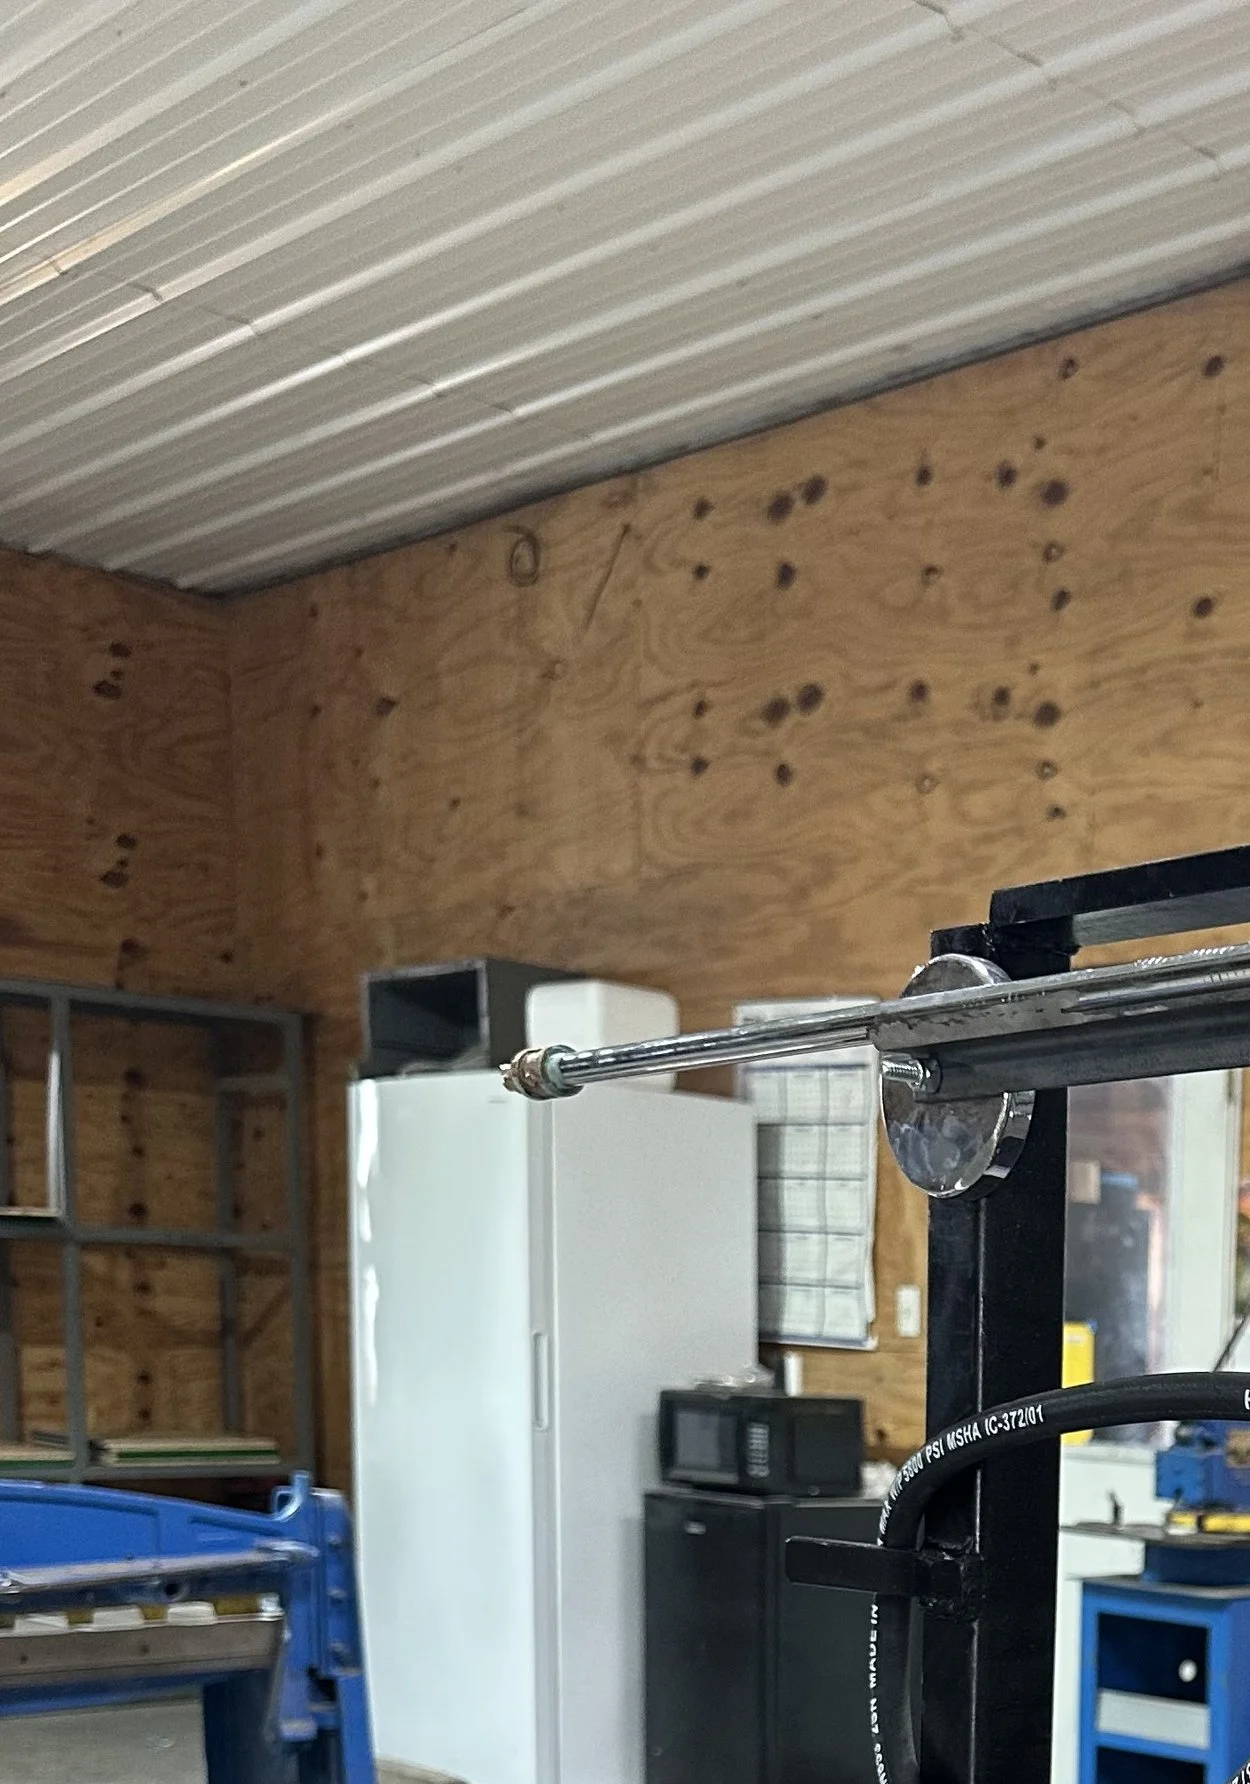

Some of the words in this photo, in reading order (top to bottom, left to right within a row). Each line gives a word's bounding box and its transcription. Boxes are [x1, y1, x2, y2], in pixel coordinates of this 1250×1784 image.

[902, 1451, 924, 1482] 5800
[925, 1437, 946, 1463] PSI
[946, 1421, 982, 1451] MSHA
[984, 1404, 1044, 1436] IC-372/01
